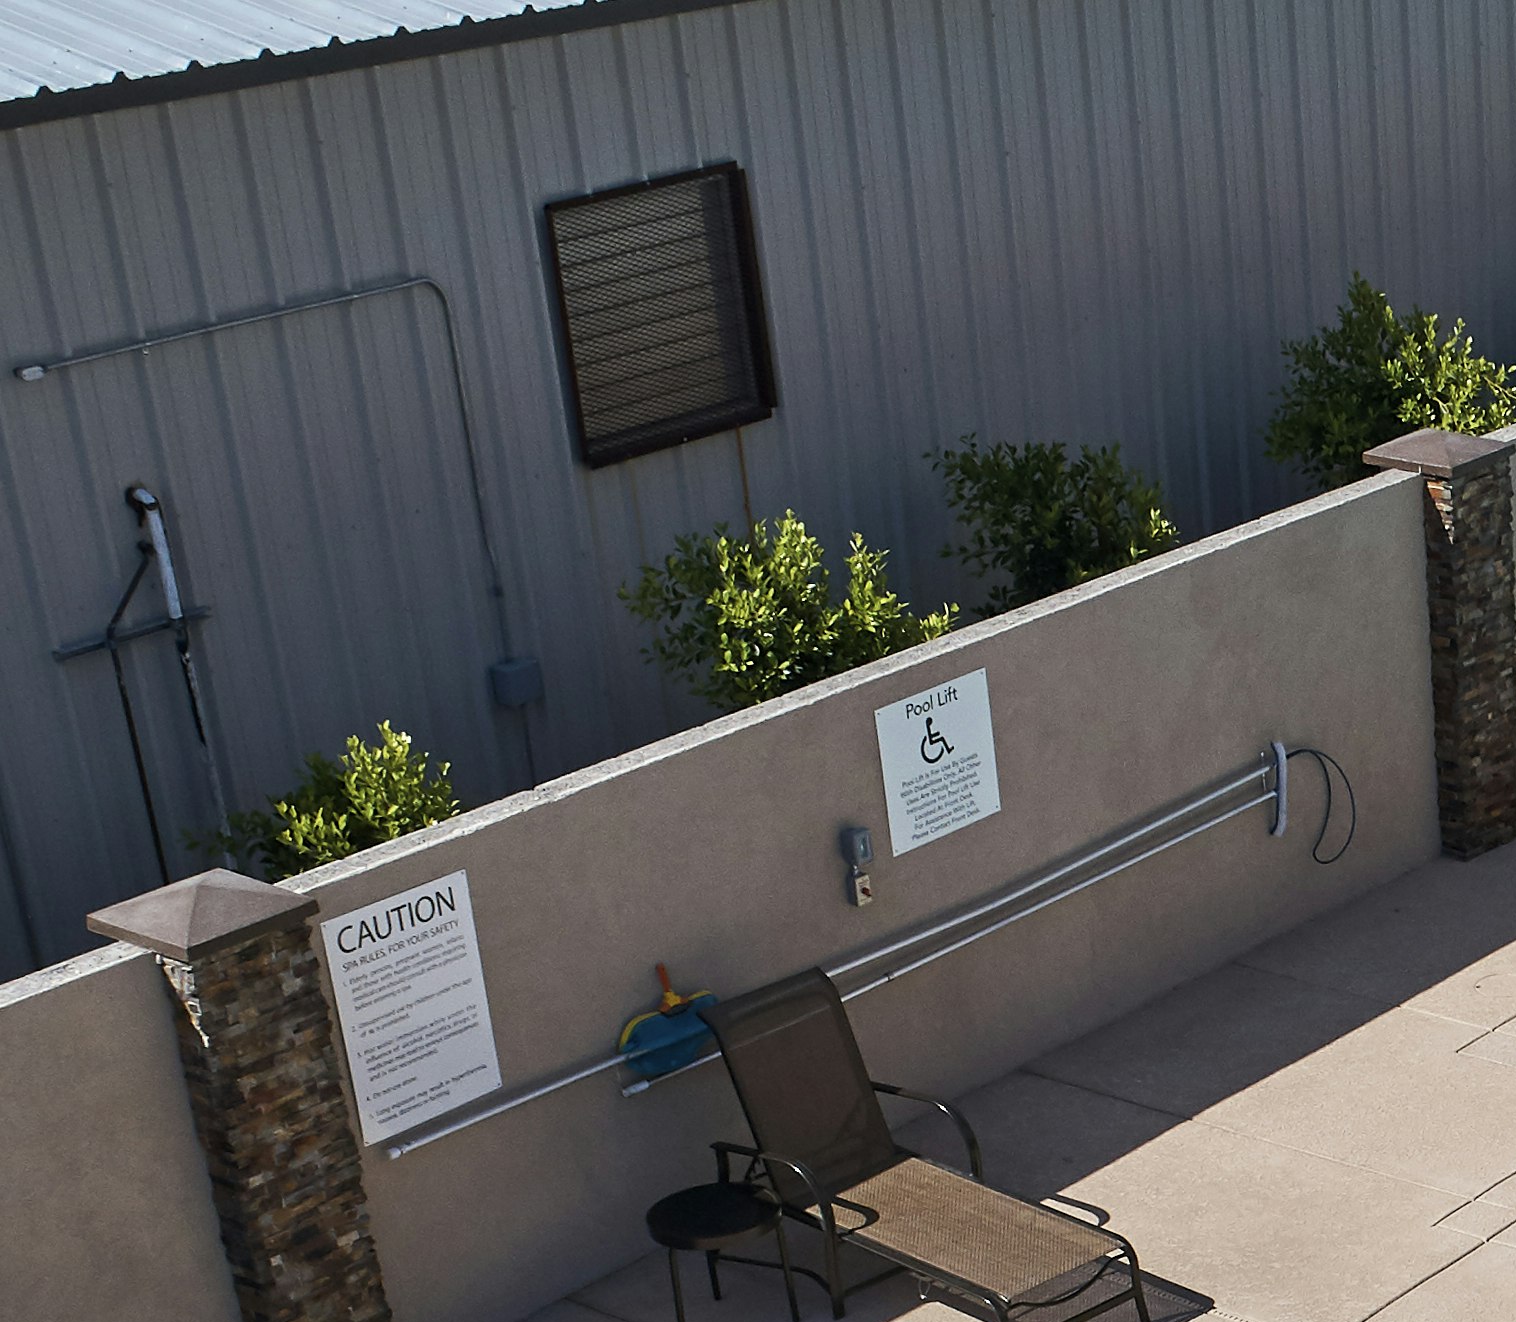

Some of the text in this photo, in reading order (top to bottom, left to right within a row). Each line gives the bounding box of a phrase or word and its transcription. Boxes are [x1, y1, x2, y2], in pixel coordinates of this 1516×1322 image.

[906, 686, 958, 719] Pool Lift
[337, 886, 455, 953] CAUTION
[387, 939, 405, 954] FOR
[407, 930, 429, 946] YOUR
[429, 917, 460, 937] SAFETY
